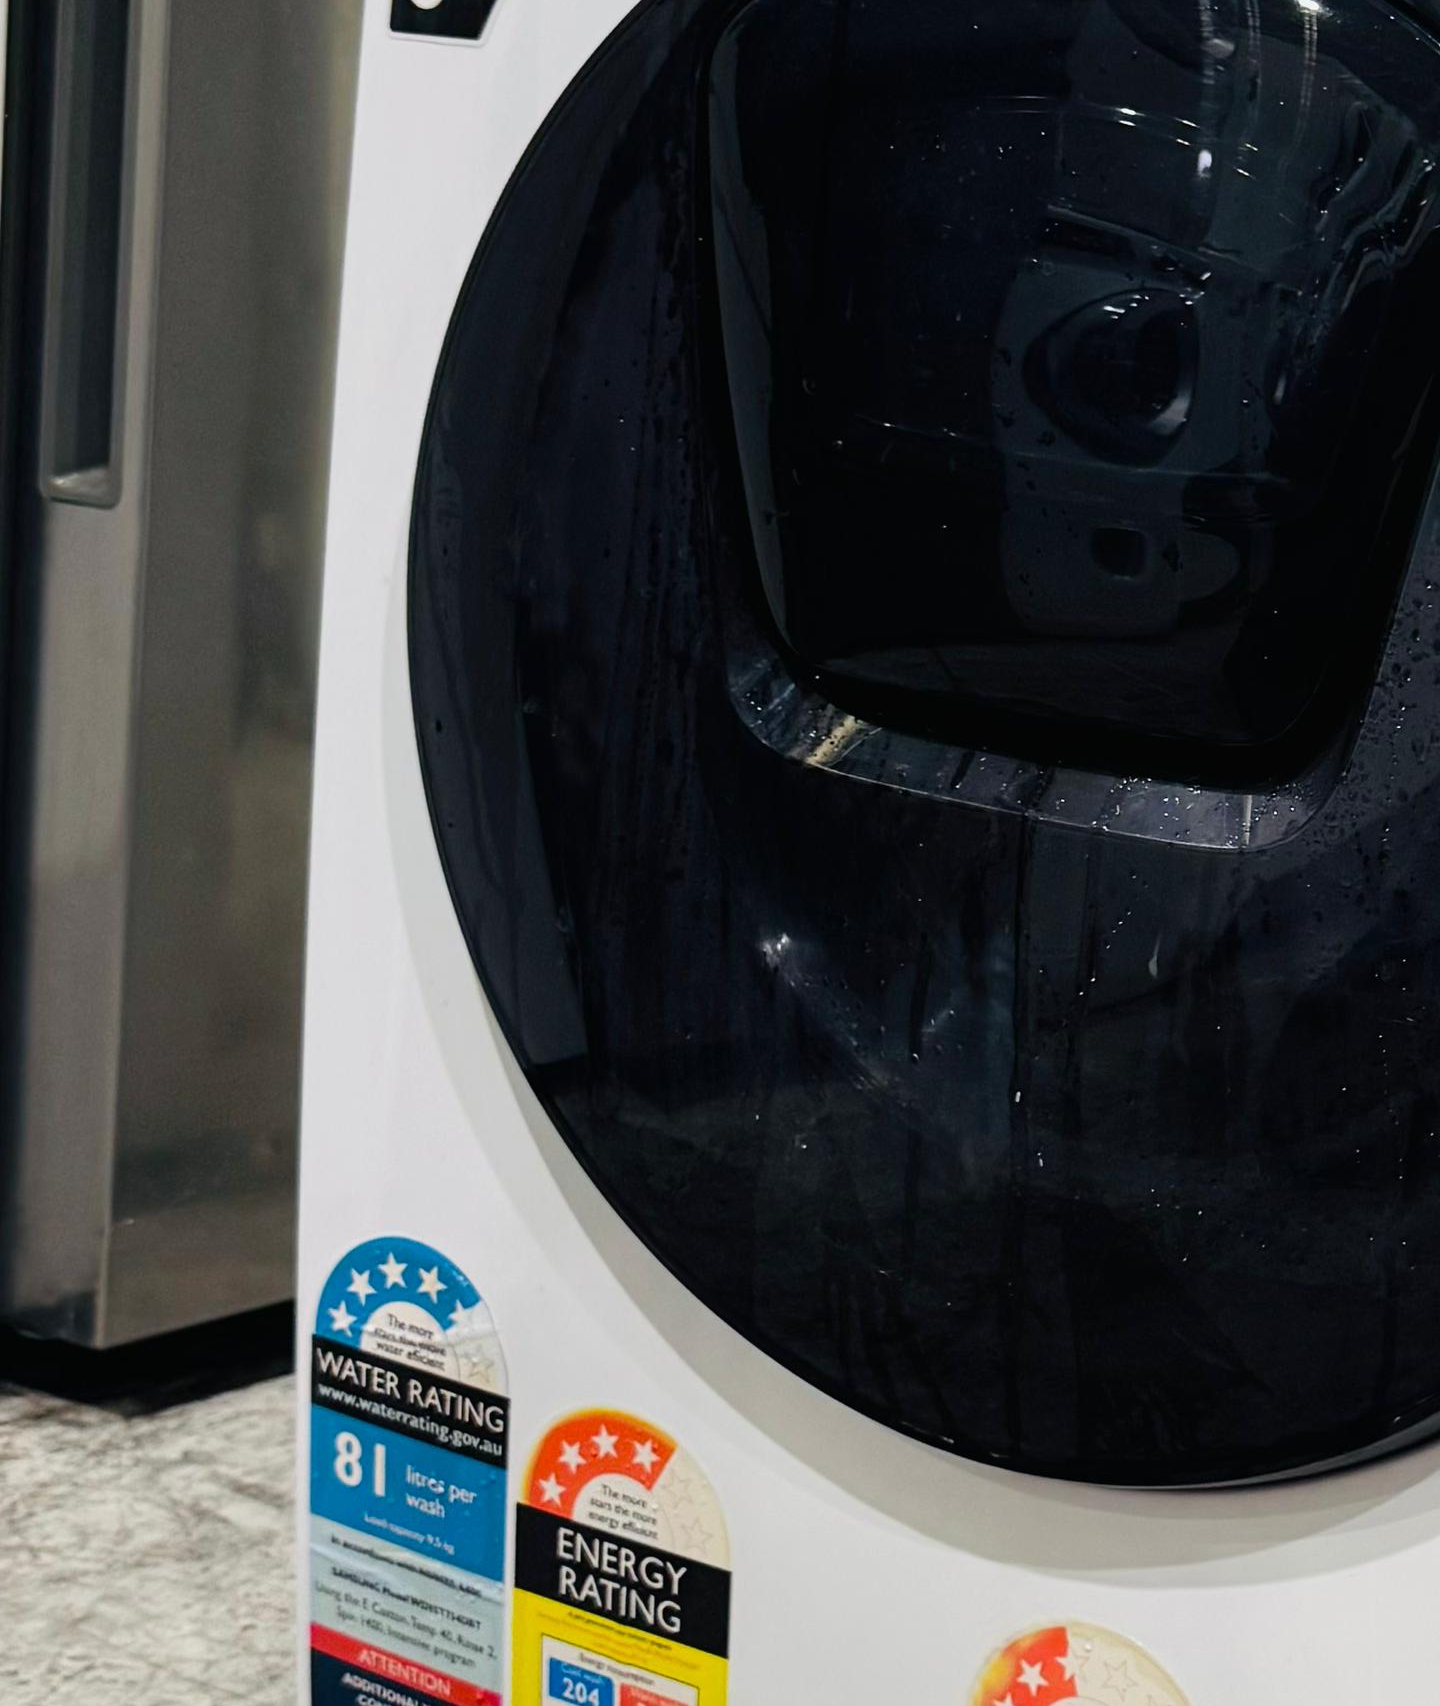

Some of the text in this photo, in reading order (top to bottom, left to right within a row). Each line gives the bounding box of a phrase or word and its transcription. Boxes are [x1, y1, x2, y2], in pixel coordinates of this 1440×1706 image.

[387, 1312, 434, 1341] The more
[376, 1342, 404, 1359] water
[315, 1347, 504, 1433] WATER RATING
[317, 1383, 503, 1457] www.waterrating.gov.au
[405, 1465, 478, 1505] litres per
[602, 1484, 648, 1509] The more
[405, 1493, 446, 1519] wash
[588, 1510, 620, 1530] energy
[590, 1497, 658, 1526] stars the more
[556, 1526, 688, 1596] ENERGY
[558, 1565, 682, 1634] RATING
[357, 1648, 450, 1697] ATTENTION
